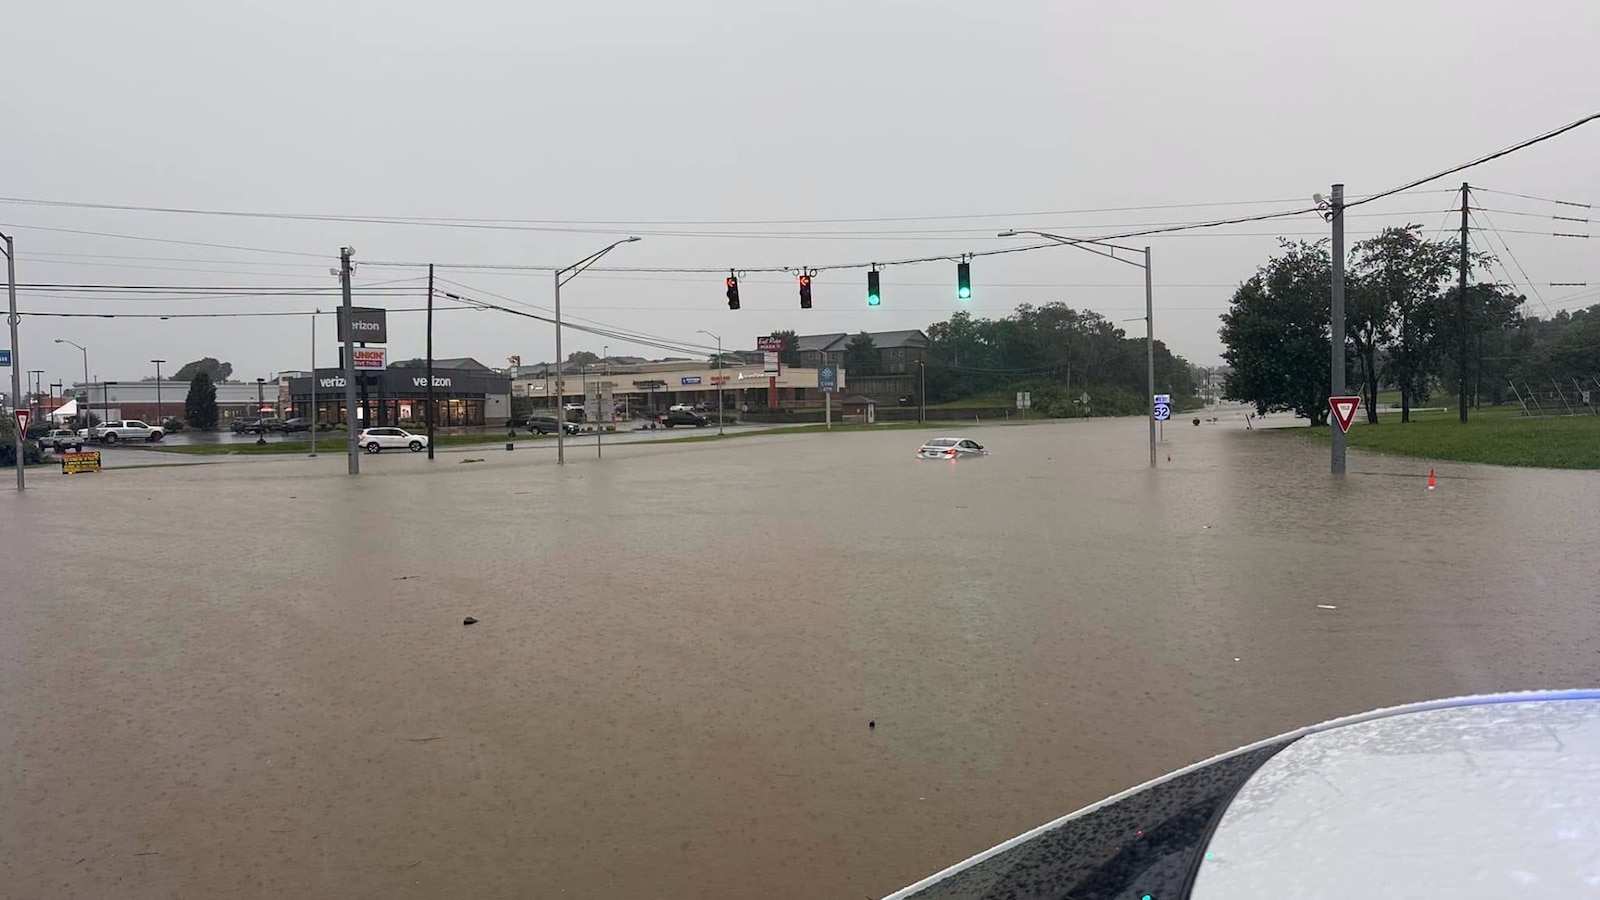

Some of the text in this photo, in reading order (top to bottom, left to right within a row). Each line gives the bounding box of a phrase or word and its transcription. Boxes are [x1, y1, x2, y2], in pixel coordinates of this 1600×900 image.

[352, 320, 379, 330] erizon
[413, 375, 451, 387] veizon
[1154, 407, 1167, 417] 52
